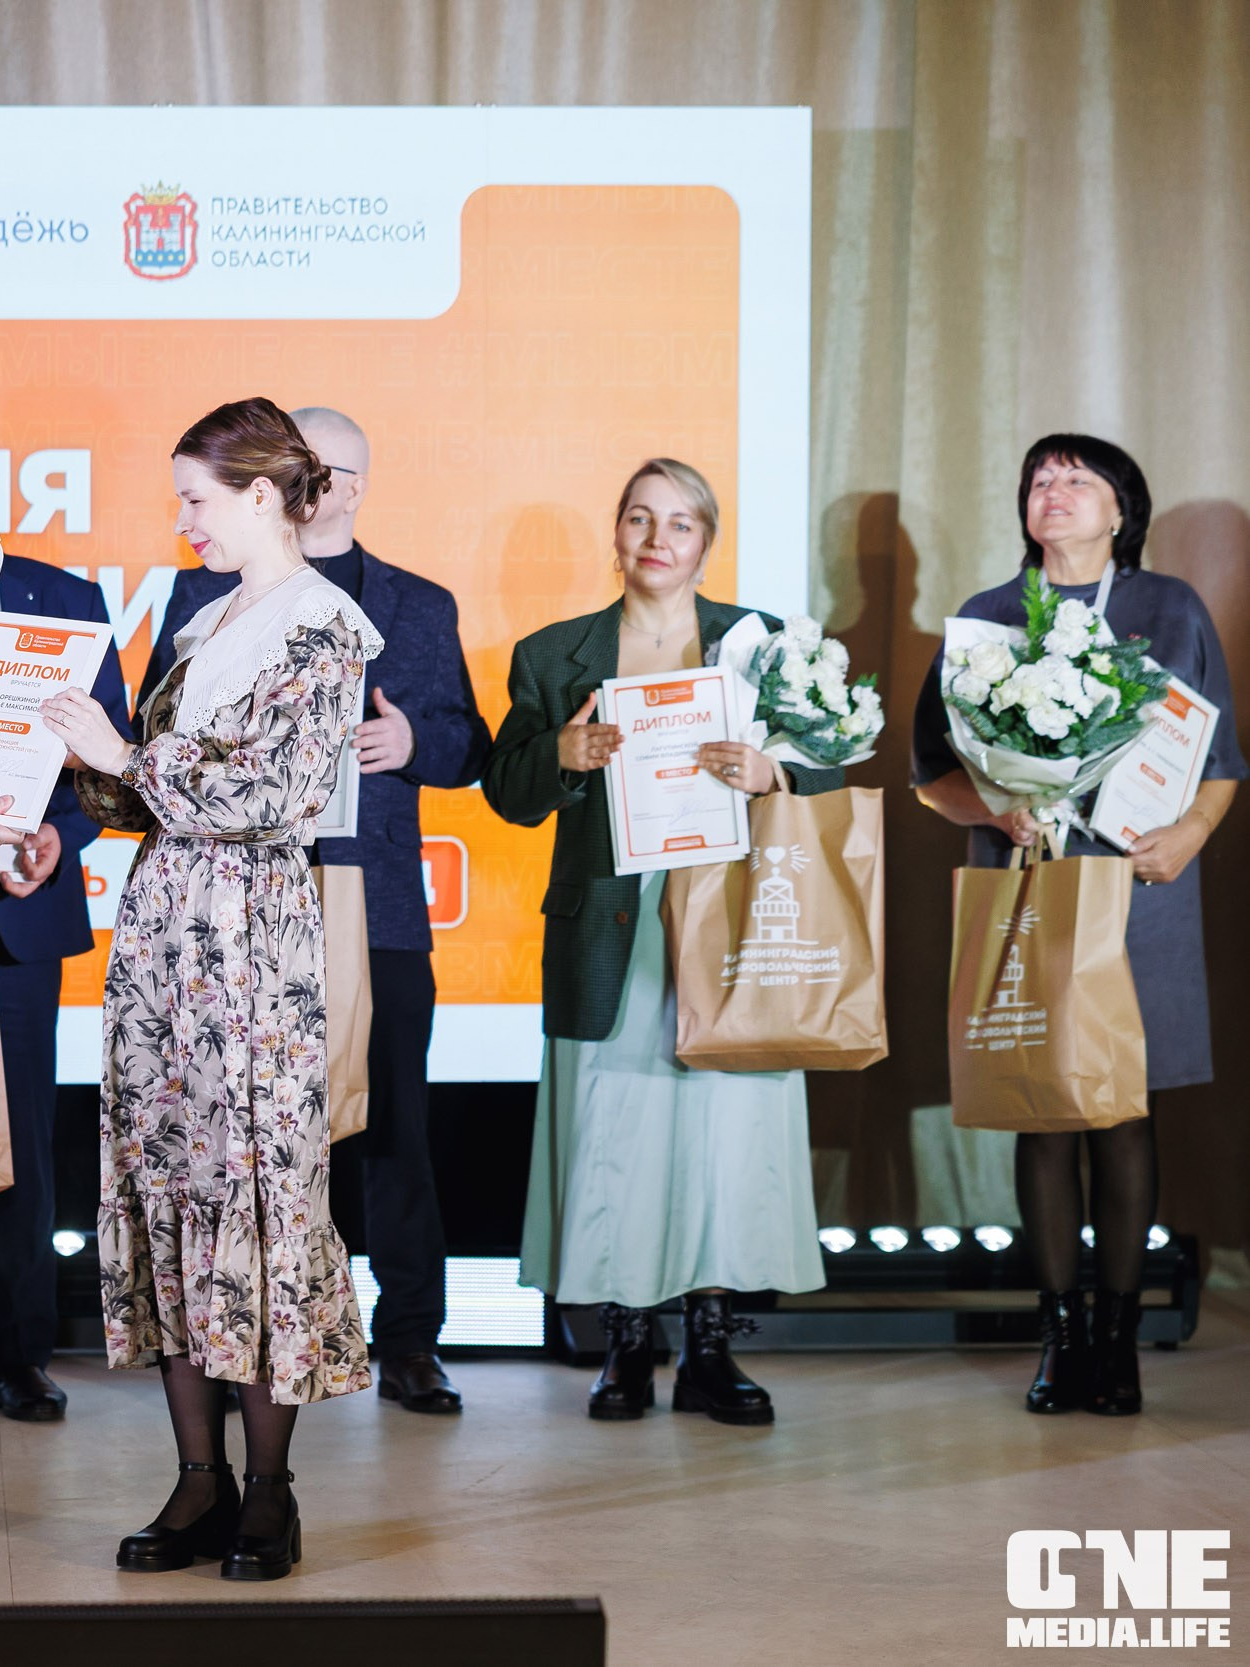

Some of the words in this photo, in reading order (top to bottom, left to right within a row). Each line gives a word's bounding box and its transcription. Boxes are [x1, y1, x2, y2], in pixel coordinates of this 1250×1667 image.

[211, 197, 388, 215] ПРАВИТЕЛЬСТВО
[211, 221, 426, 243] КАЛИНИНГРАДСКОЙ
[211, 251, 310, 267] ОБЛАСТИ
[10, 679, 42, 688] ВРУЧАЕТСЯ
[0, 694, 41, 704] ОРЕШКИНОЙ
[633, 711, 712, 733] ДИПЛОМ
[759, 975, 798, 986] ЦЕНТР
